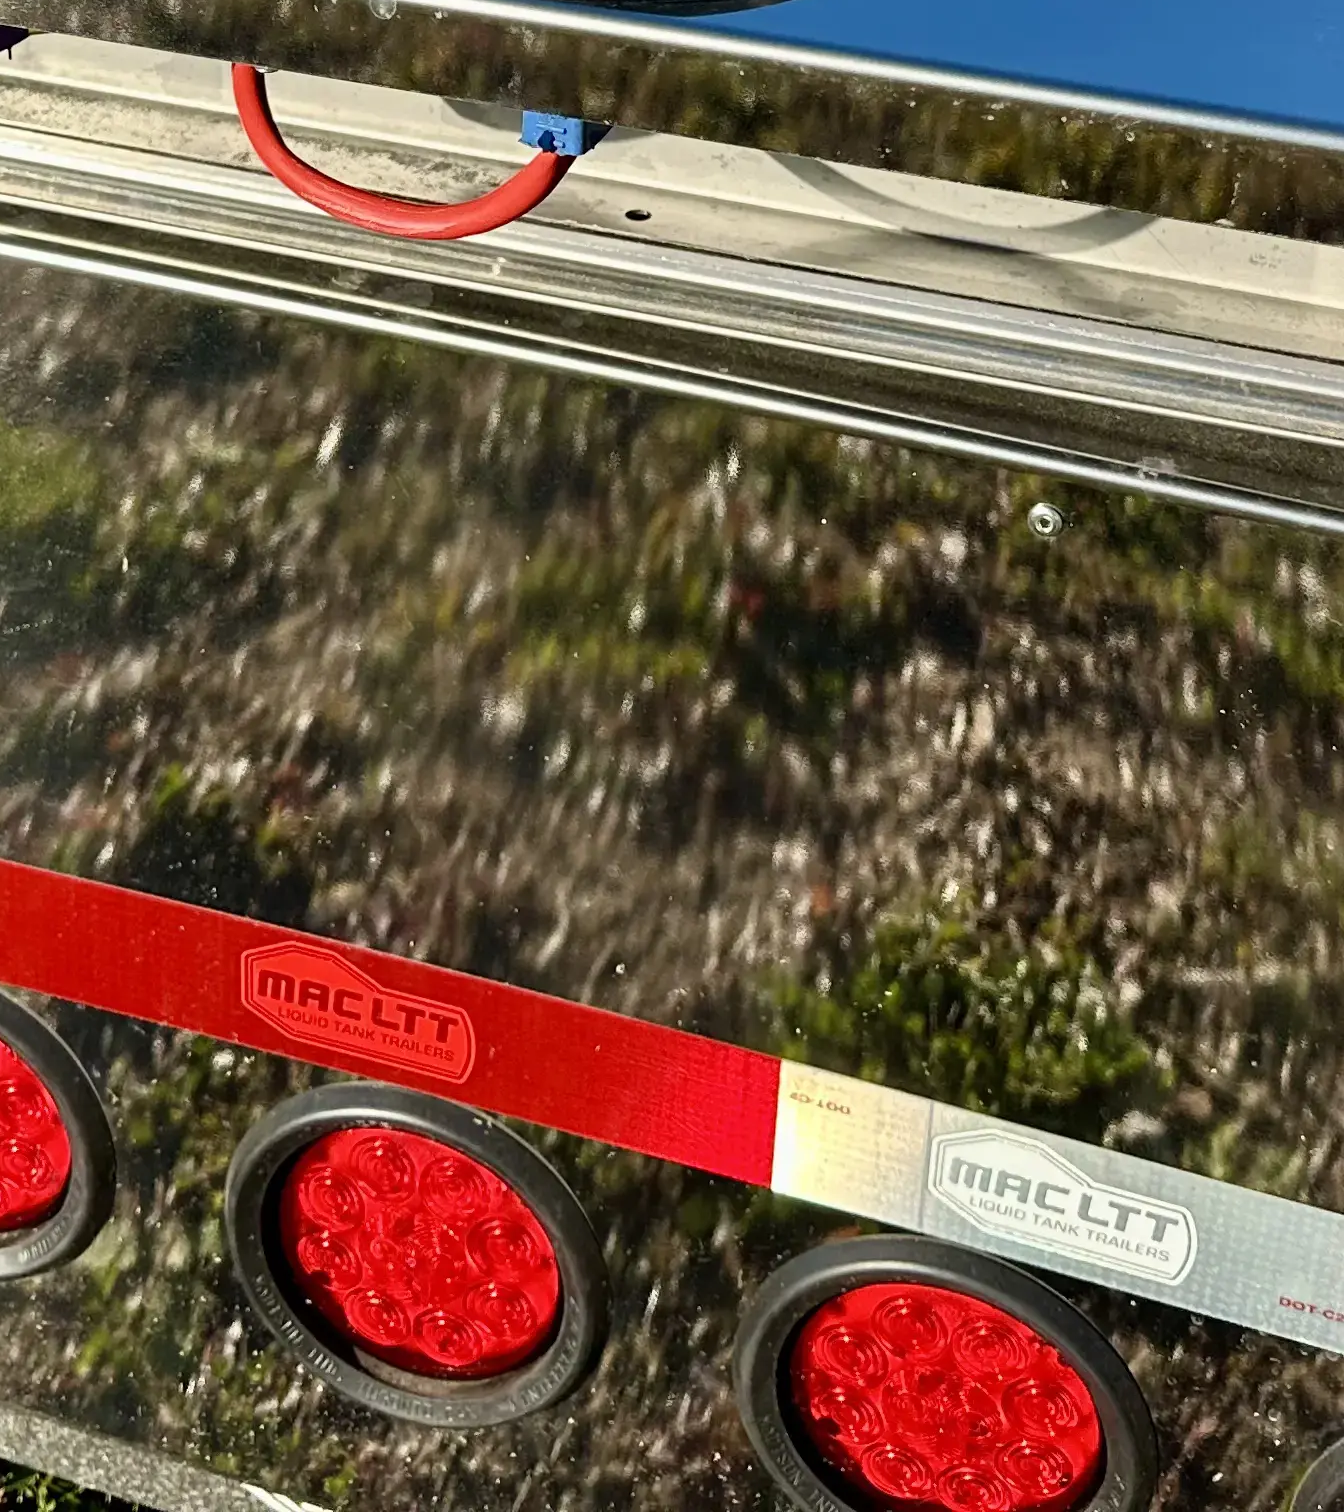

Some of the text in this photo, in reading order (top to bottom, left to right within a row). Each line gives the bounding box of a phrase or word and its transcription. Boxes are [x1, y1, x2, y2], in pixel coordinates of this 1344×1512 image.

[257, 969, 460, 1044] MAC LTT
[276, 1006, 455, 1063] LIQUID TANK TRAILERS
[948, 1156, 1178, 1243] MAC LTT
[969, 1195, 1171, 1263] LIQUID TANK TRAILERS
